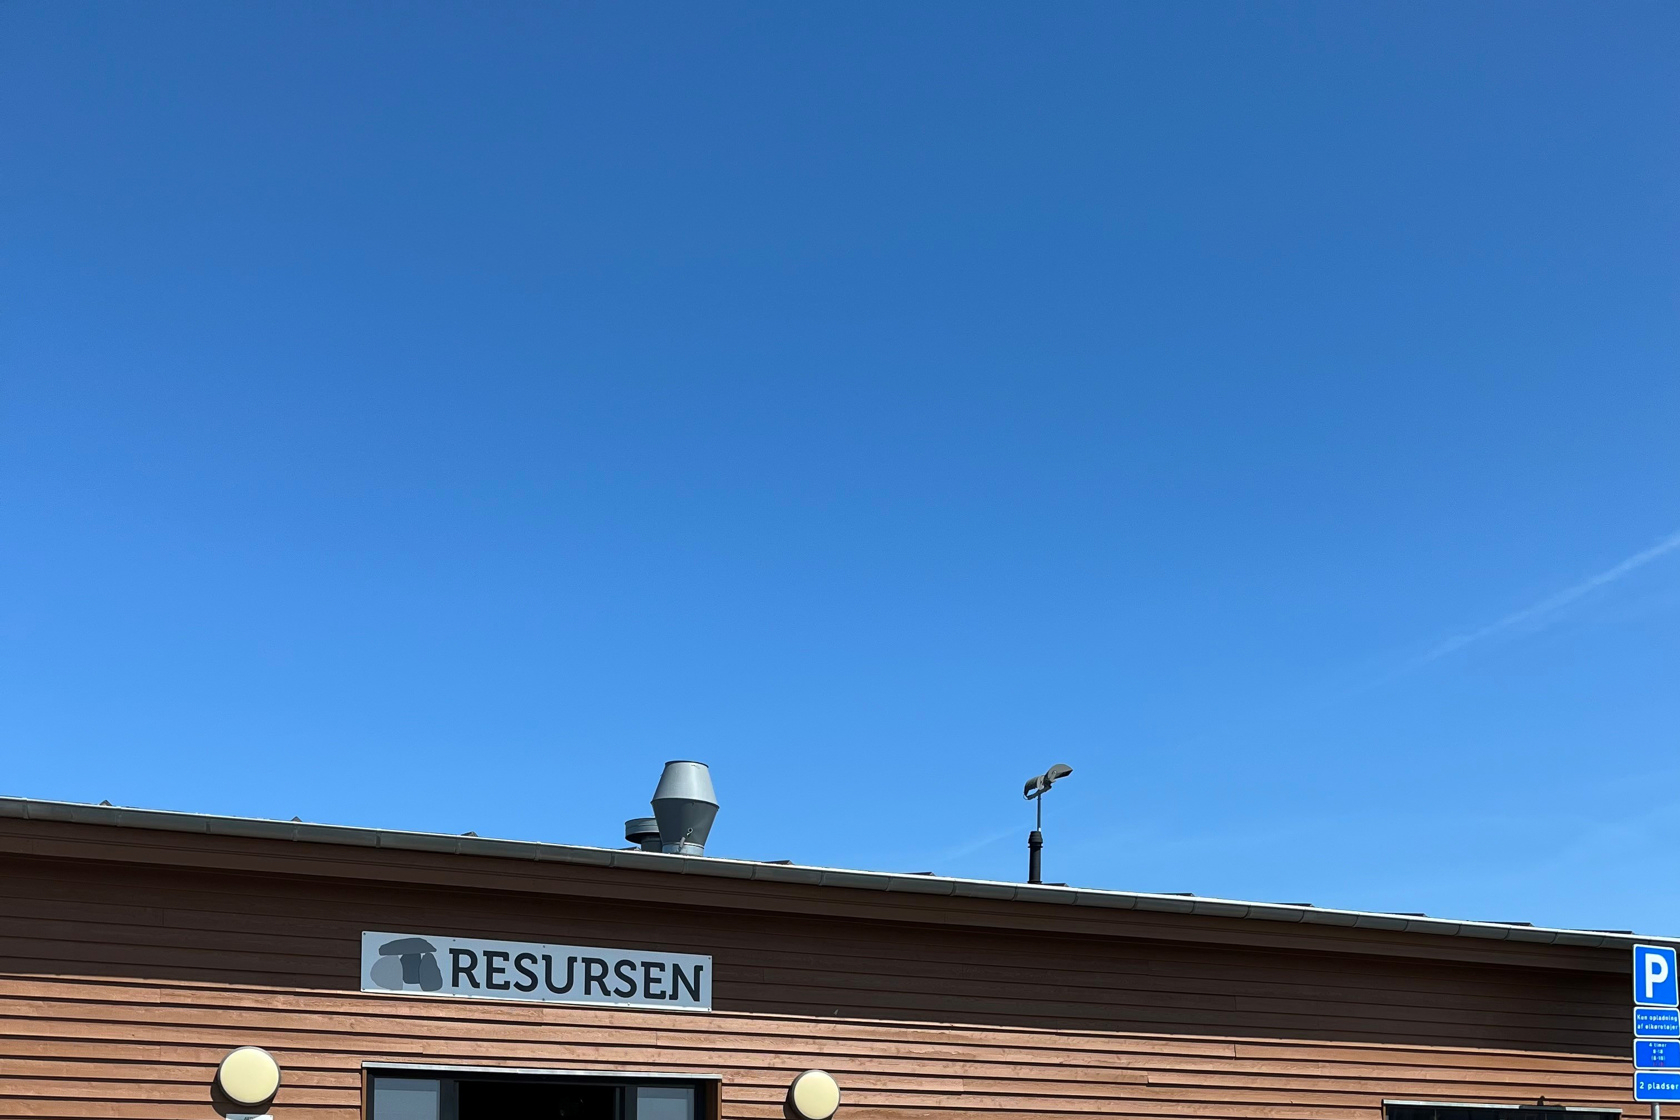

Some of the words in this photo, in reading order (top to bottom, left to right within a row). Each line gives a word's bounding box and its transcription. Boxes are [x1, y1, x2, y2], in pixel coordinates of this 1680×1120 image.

[448, 947, 704, 1002] RESURSEN
[1645, 953, 1669, 998] P
[1649, 1014, 1678, 1023] opladning
[1639, 1081, 1645, 1090] 2
[1647, 1081, 1679, 1091] pladser
